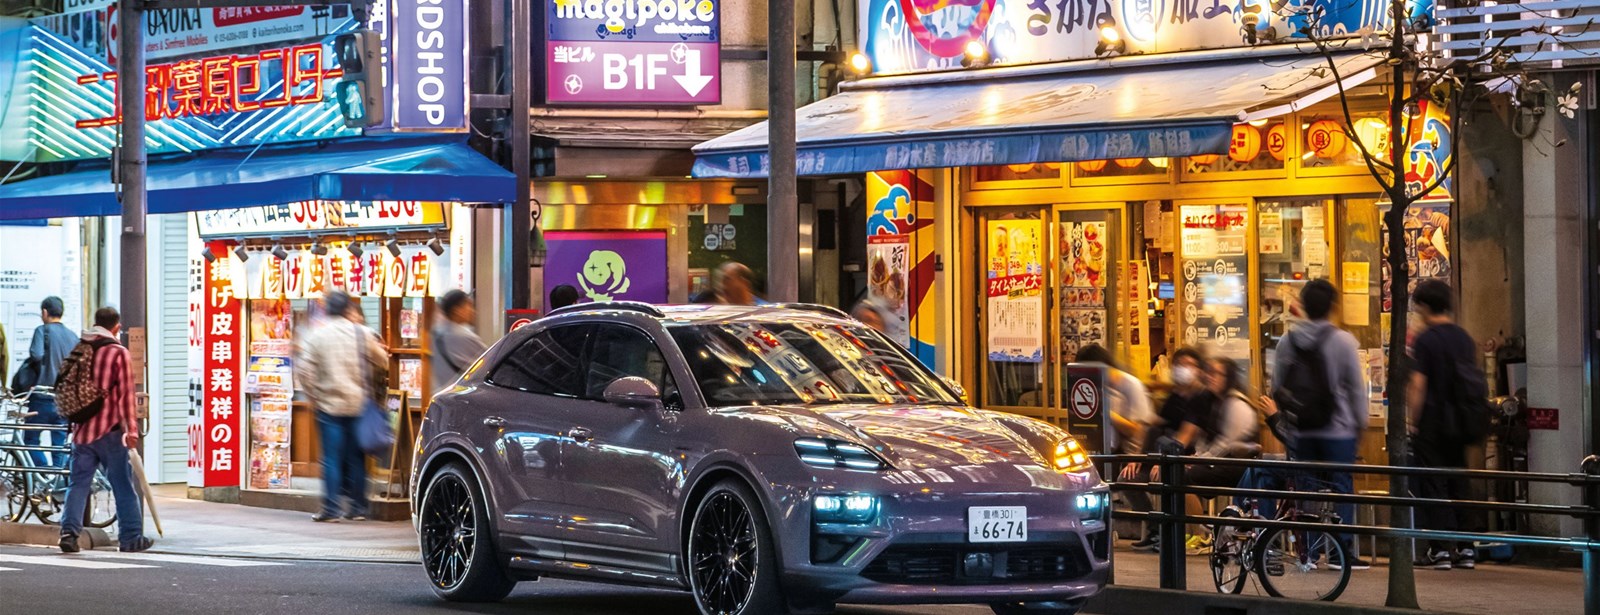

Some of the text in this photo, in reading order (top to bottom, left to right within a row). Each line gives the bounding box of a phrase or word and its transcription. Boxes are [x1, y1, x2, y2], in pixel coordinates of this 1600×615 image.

[553, 0, 714, 31] magipoke
[554, 46, 596, 62] 当ビル
[603, 53, 668, 90] B1F
[990, 275, 1040, 294] タイムサービス
[982, 521, 1024, 539] 66-74
